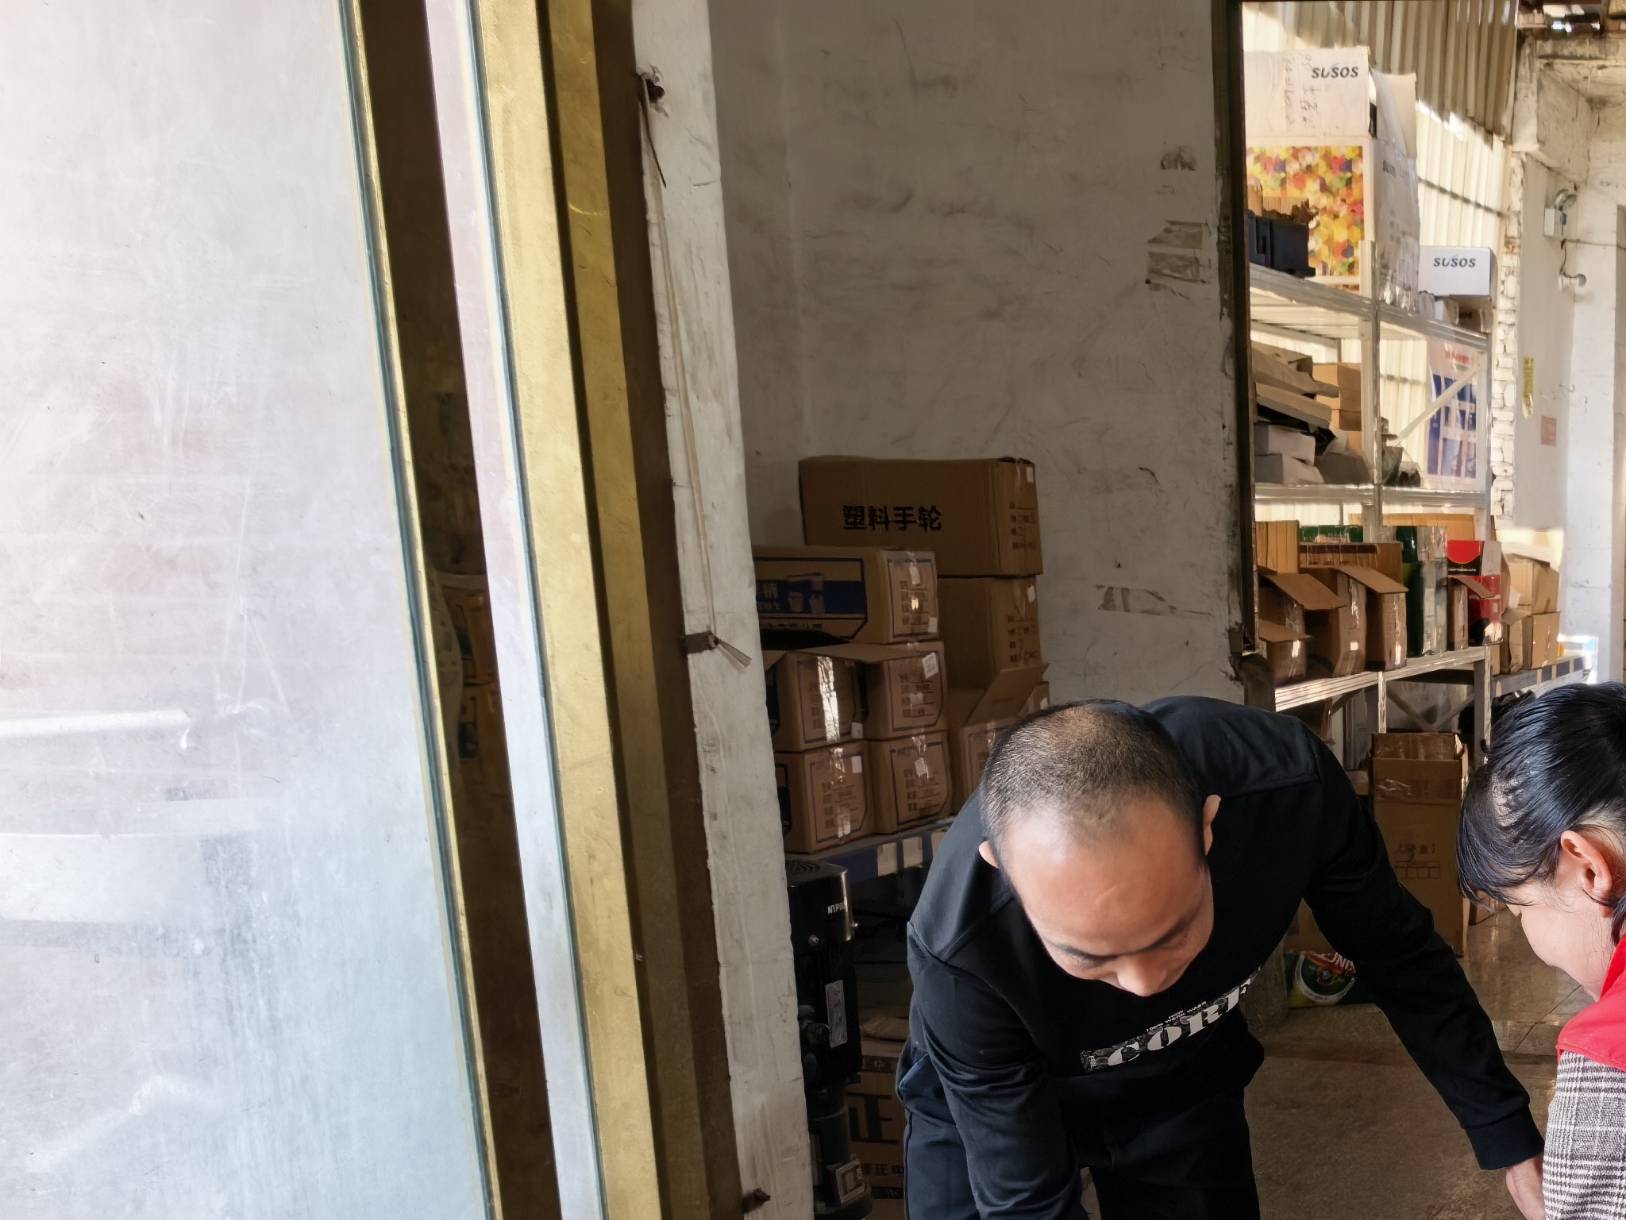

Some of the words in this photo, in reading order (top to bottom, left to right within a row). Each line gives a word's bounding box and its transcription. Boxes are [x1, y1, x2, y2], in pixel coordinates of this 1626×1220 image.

[1312, 66, 1359, 79] SUSOS
[1433, 256, 1477, 268] SUSOS
[842, 505, 943, 532] 塑料手轮
